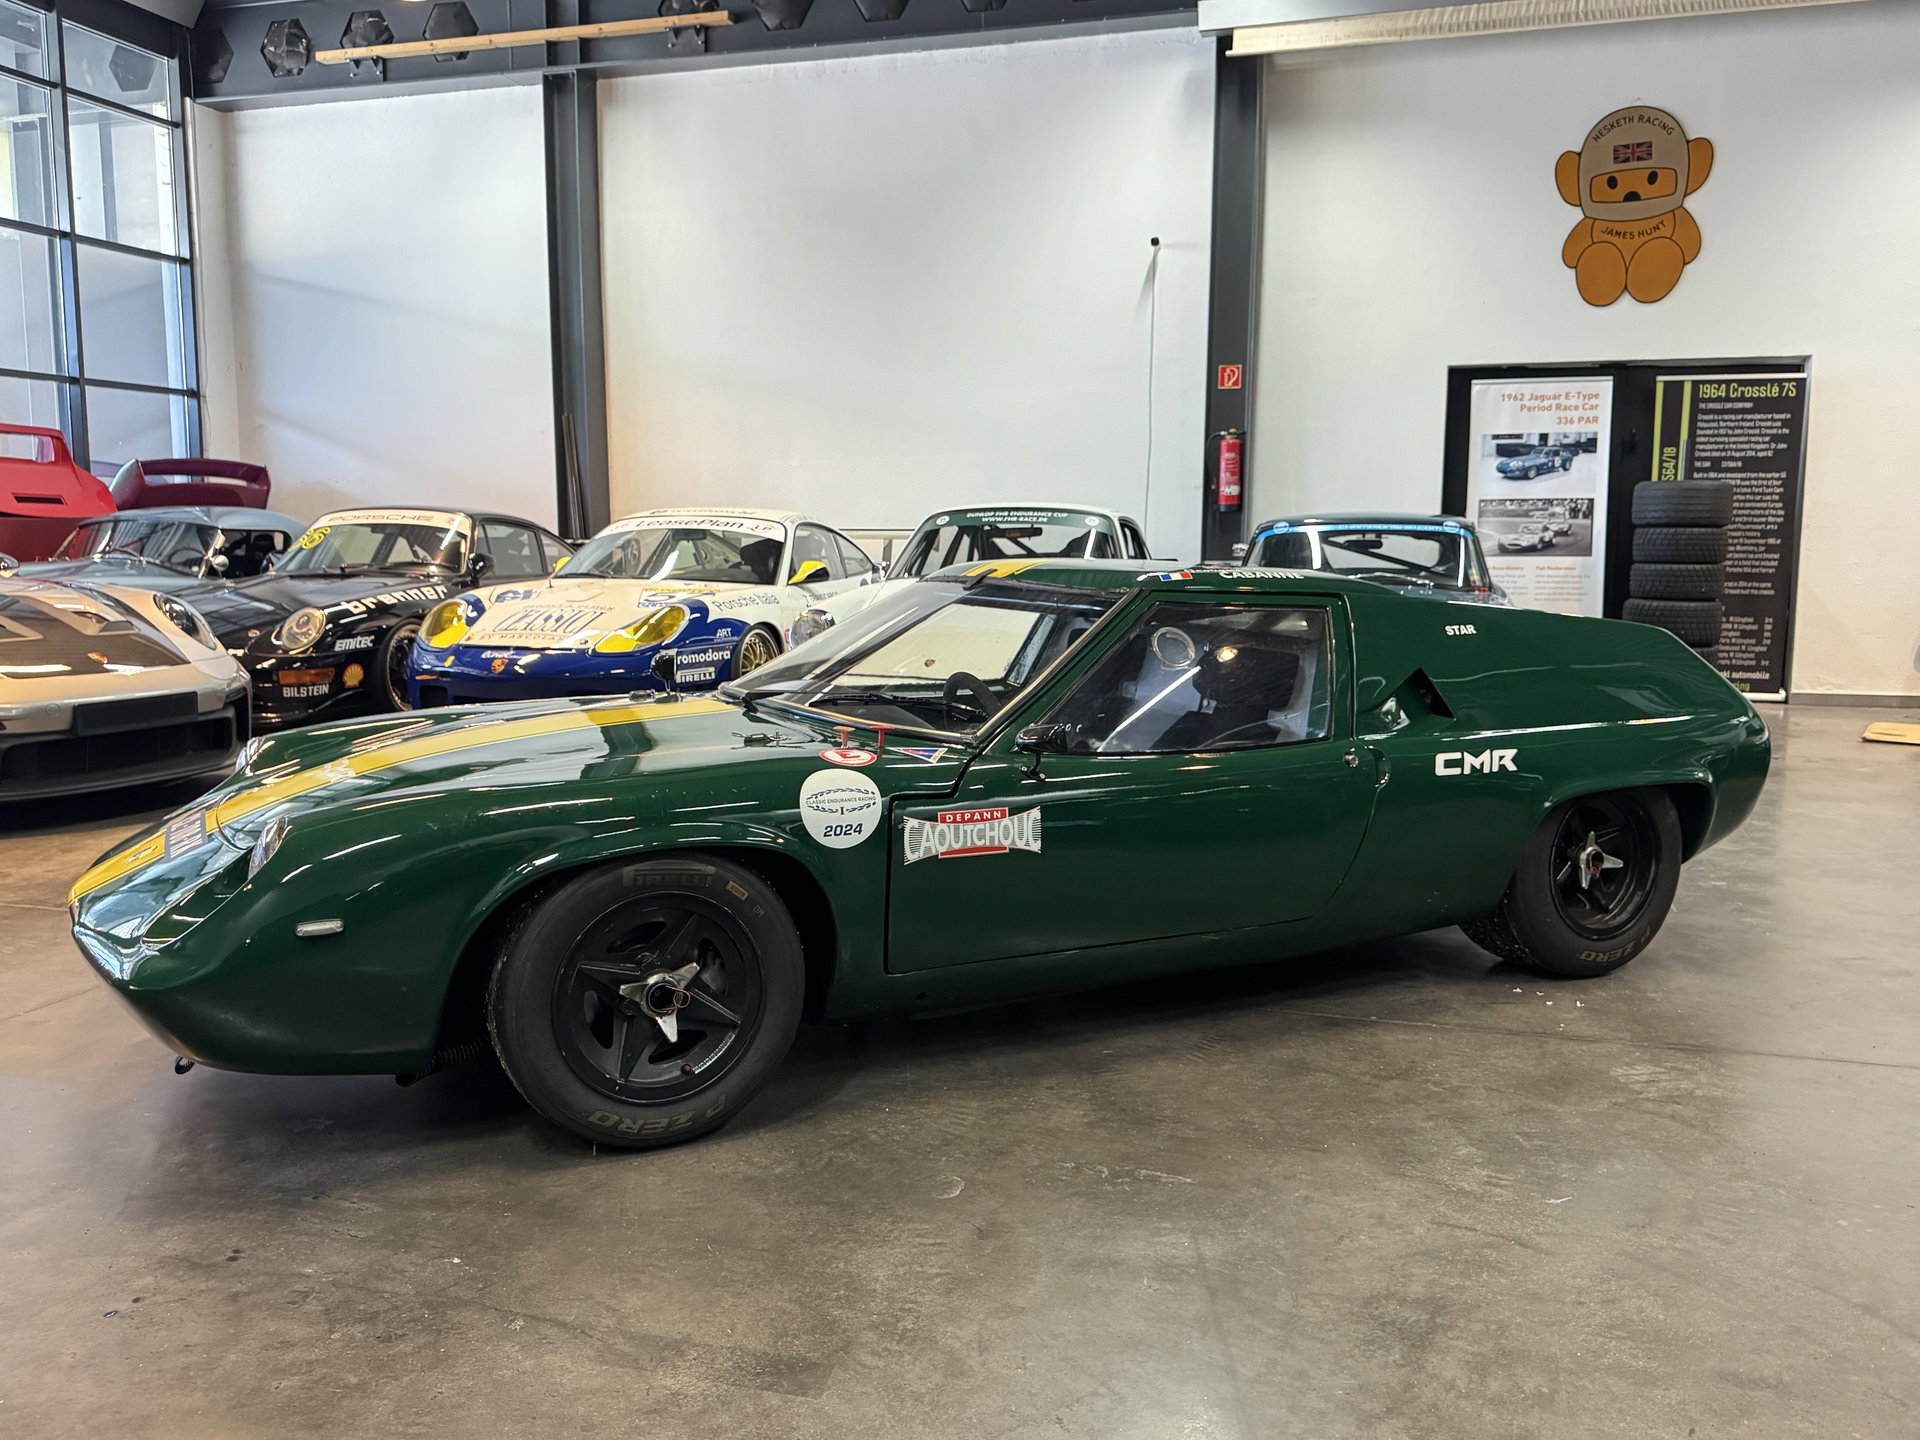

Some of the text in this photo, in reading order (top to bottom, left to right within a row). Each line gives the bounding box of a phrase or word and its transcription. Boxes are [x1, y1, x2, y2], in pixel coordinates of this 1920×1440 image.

[1592, 114, 1675, 142] HESKETH RACING
[1601, 220, 1666, 240] JAMES HUNT
[1699, 381, 1797, 398] 1964 Crosslé 7S
[1501, 391, 1600, 403] 1962 Jaguar E-Type
[1520, 402, 1600, 412] Period Race Car
[1556, 415, 1599, 425] 336 PAR
[328, 514, 434, 522] PORSCHE
[636, 518, 744, 529] LeasePlan
[1219, 570, 1304, 579] CABANNE
[712, 596, 759, 612] Porsche
[716, 628, 732, 639] ART
[1445, 624, 1478, 636] STAR
[677, 648, 731, 665] romodora
[676, 666, 716, 684] PIRELLI
[283, 684, 330, 697] BILSTEIN
[1435, 749, 1518, 776] CMR
[946, 810, 1002, 823] DEPANN
[824, 823, 864, 837] 2024
[904, 807, 1041, 861] CAOUTCHOUC
